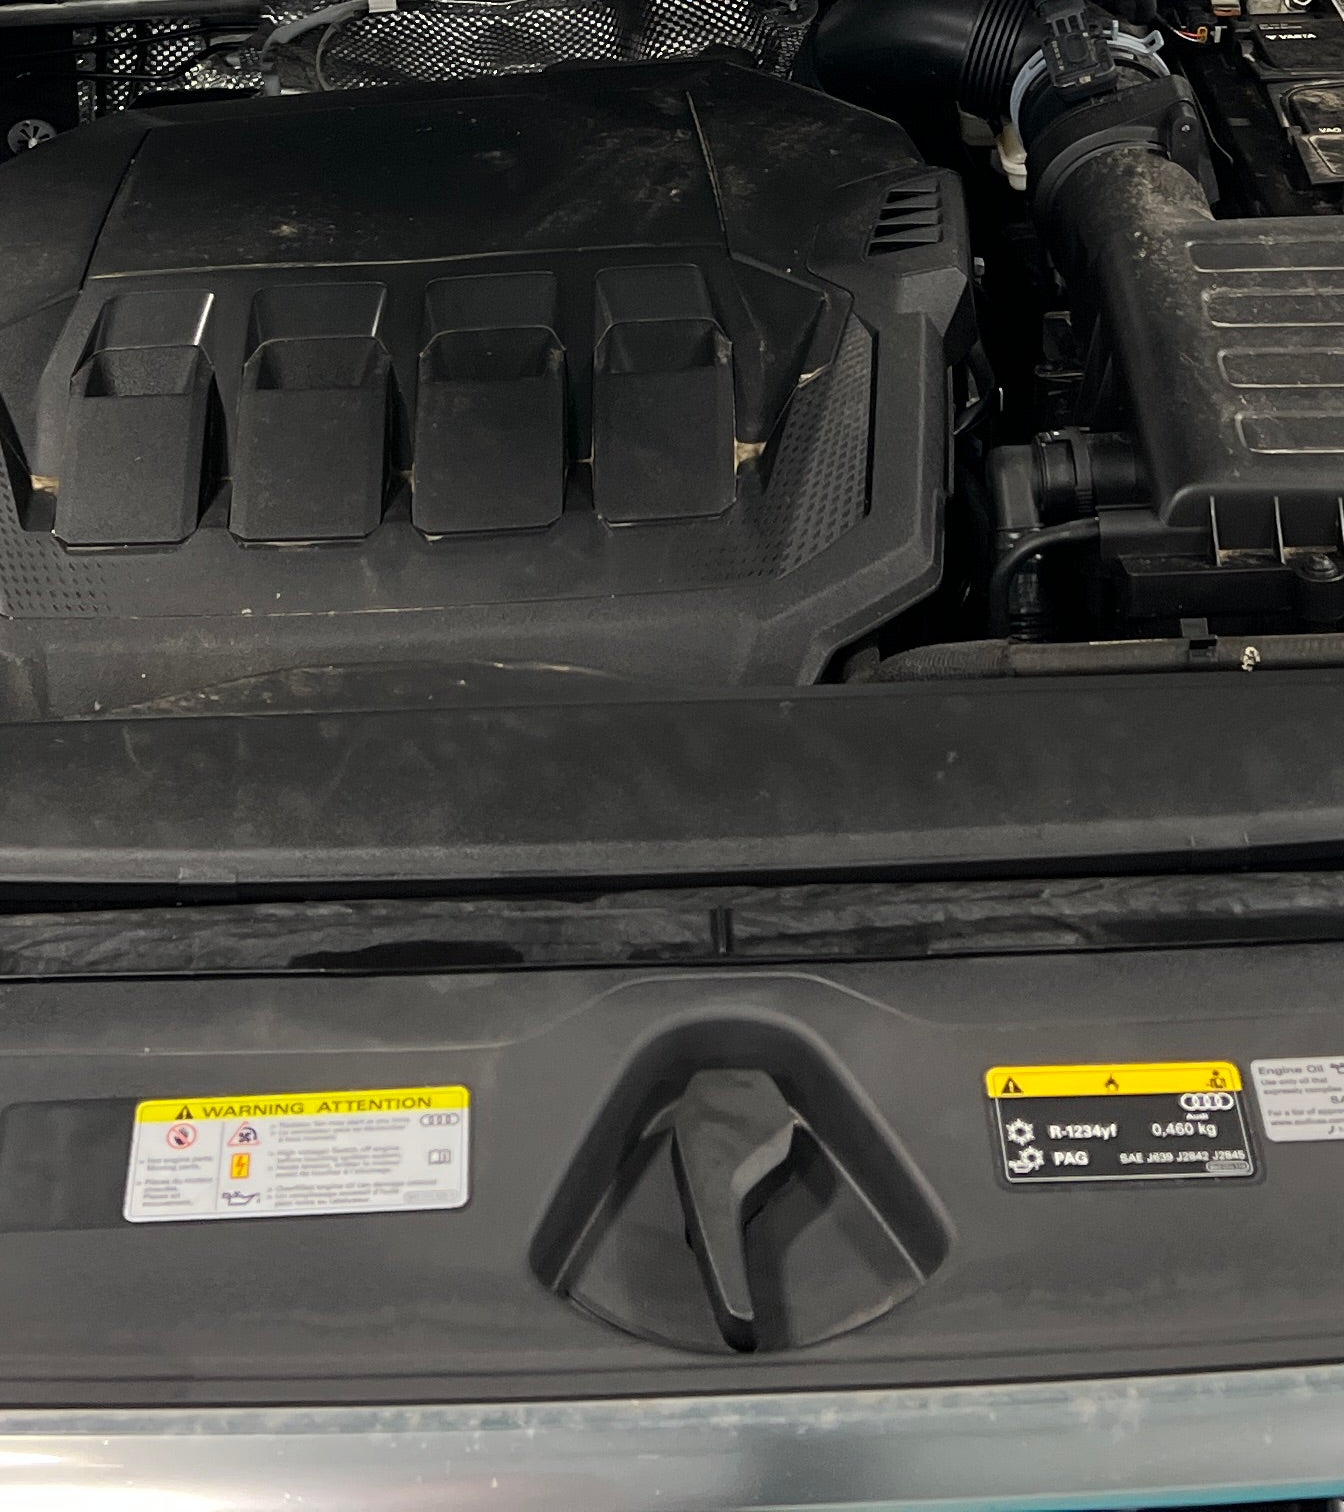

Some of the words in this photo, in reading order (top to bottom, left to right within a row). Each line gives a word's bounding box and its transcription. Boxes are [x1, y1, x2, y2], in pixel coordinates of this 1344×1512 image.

[1258, 1066, 1303, 1076] Engine
[1306, 1064, 1324, 1073] Oil
[202, 1102, 304, 1118] WARNING
[316, 1096, 433, 1113] ATTENTION
[1049, 1123, 1118, 1141] R-1234yf
[1151, 1122, 1195, 1138] 0,460
[1197, 1121, 1218, 1138] kg
[1054, 1150, 1089, 1166] PAG
[1119, 1152, 1144, 1164] SAE
[1146, 1152, 1174, 1164] J639
